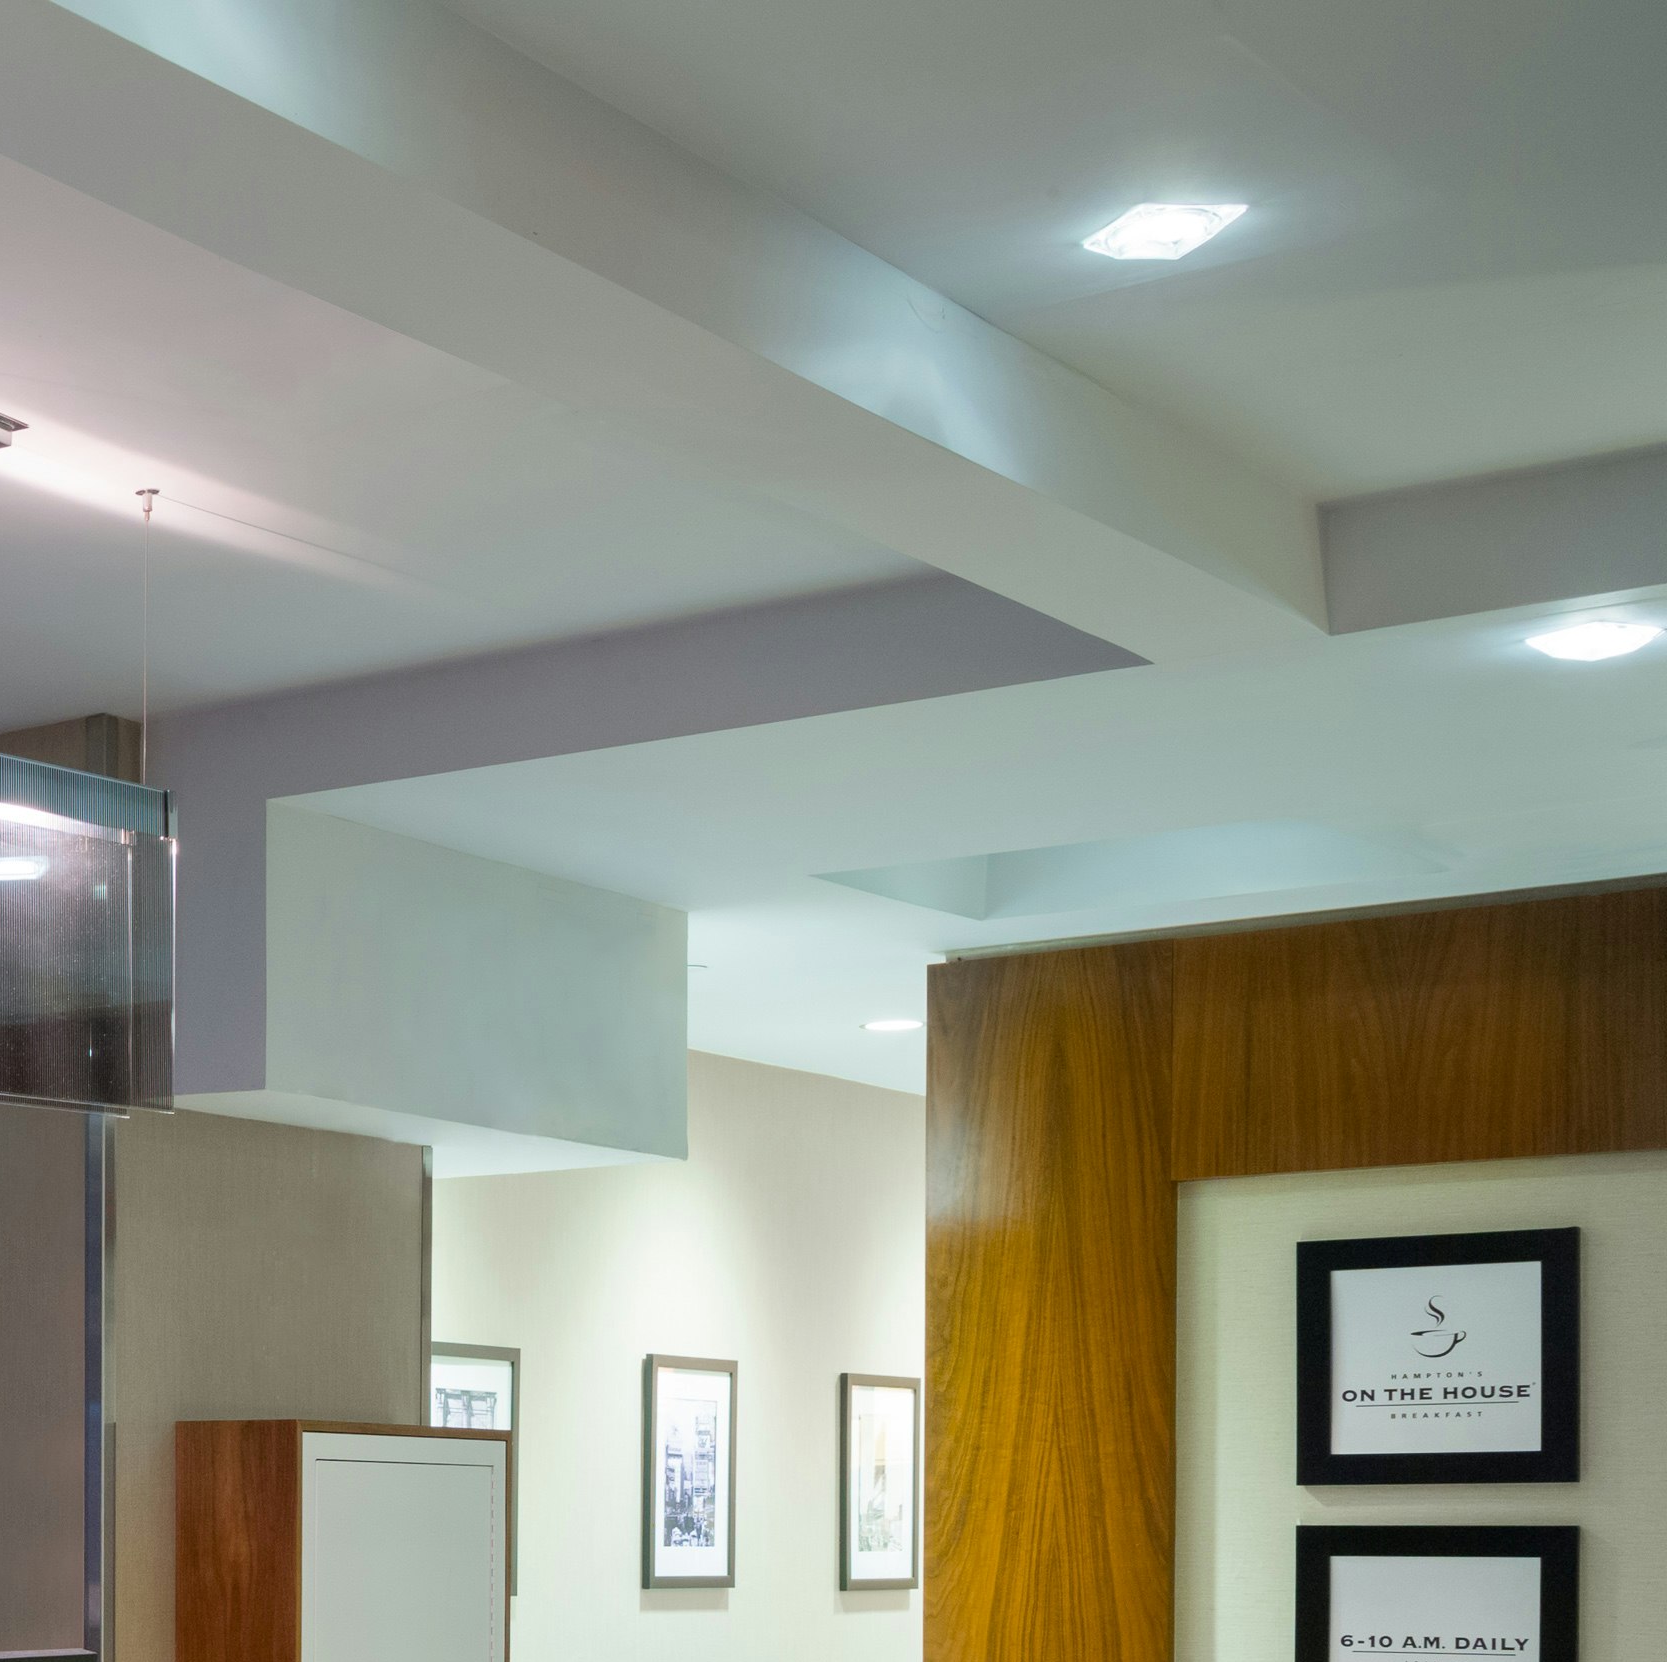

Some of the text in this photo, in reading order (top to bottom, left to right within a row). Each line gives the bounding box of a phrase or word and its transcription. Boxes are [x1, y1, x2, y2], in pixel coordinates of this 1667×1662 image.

[1391, 1371, 1483, 1380] HAMPTON'S
[1341, 1385, 1531, 1402] ON THE HOUSE
[1391, 1411, 1483, 1419] BREAKFAST
[1340, 1635, 1530, 1651] 6-10 A.M. DAILY
